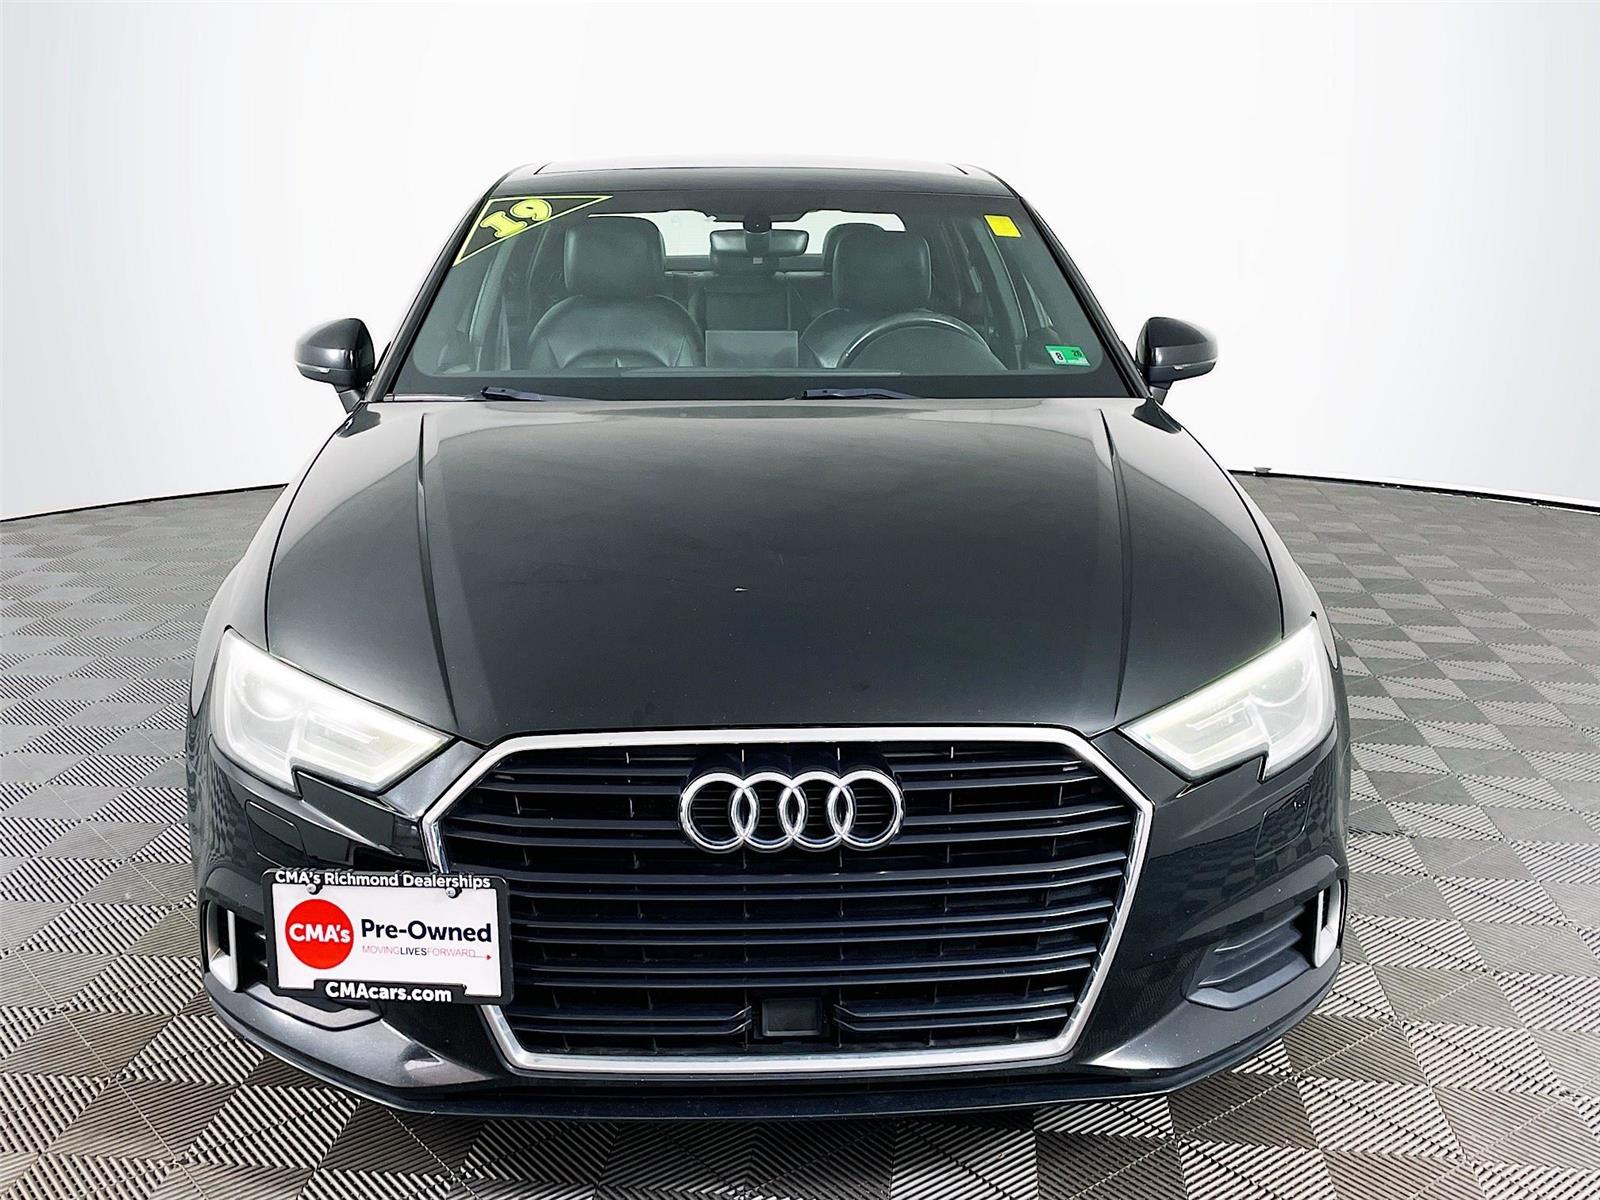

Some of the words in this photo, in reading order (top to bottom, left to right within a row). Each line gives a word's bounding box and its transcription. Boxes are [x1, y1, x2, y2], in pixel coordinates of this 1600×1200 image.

[480, 199, 552, 238] 19
[275, 871, 321, 884] CMA's
[324, 872, 399, 887] Richmond
[403, 875, 491, 889] Dealerships
[288, 923, 351, 943] CMA's
[361, 919, 492, 943] Pre-Owned
[325, 982, 452, 1002] CMAcars.com
